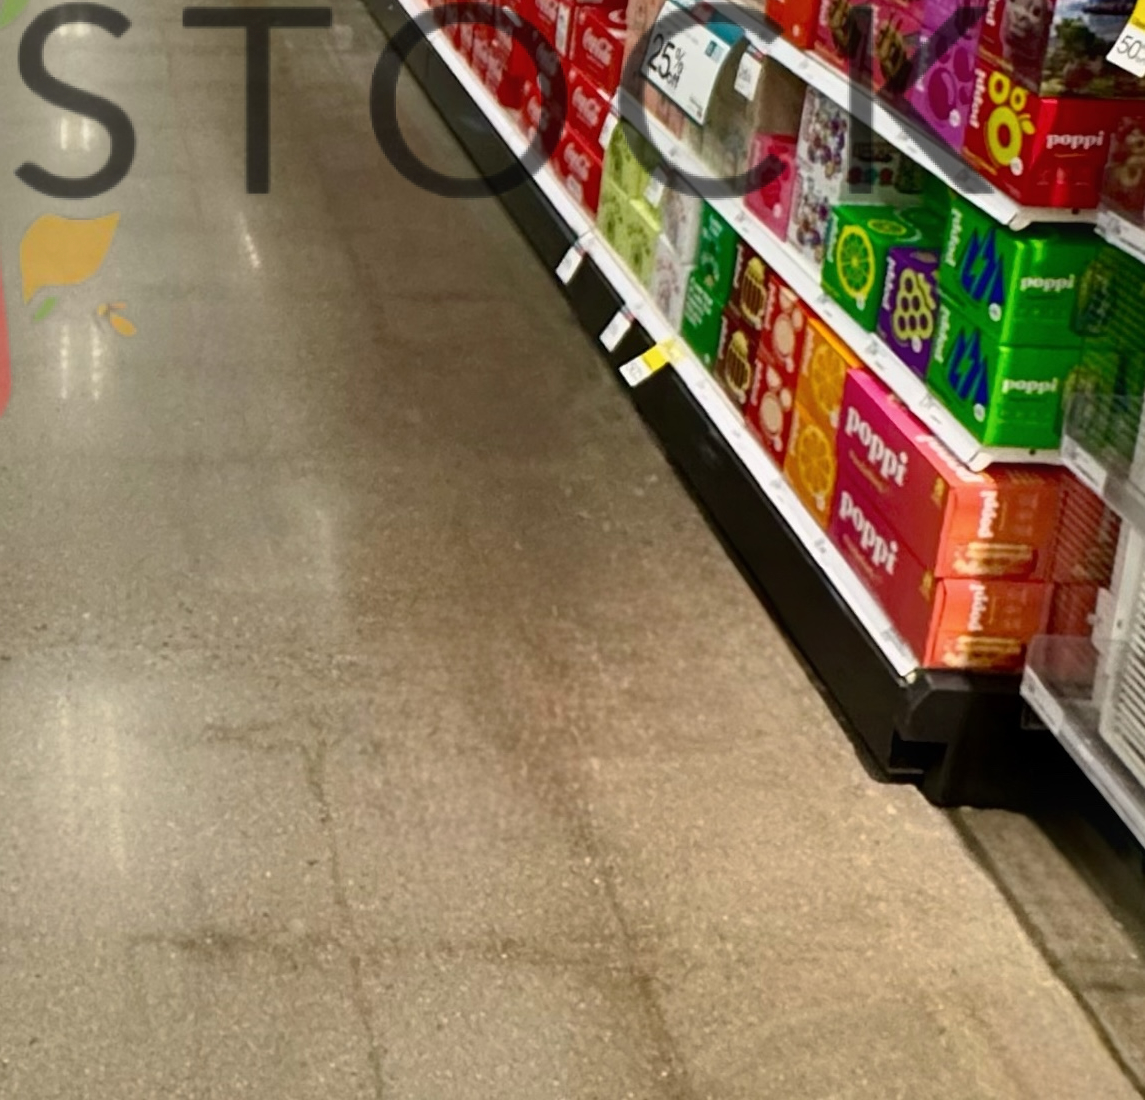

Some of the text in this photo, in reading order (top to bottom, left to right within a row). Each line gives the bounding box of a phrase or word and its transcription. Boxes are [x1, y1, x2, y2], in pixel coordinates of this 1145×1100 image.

[1046, 131, 1105, 150] poppi
[1020, 274, 1075, 291] poppi
[1002, 377, 1057, 395] poppi
[845, 406, 909, 487] poppi
[839, 490, 898, 576] poppi
